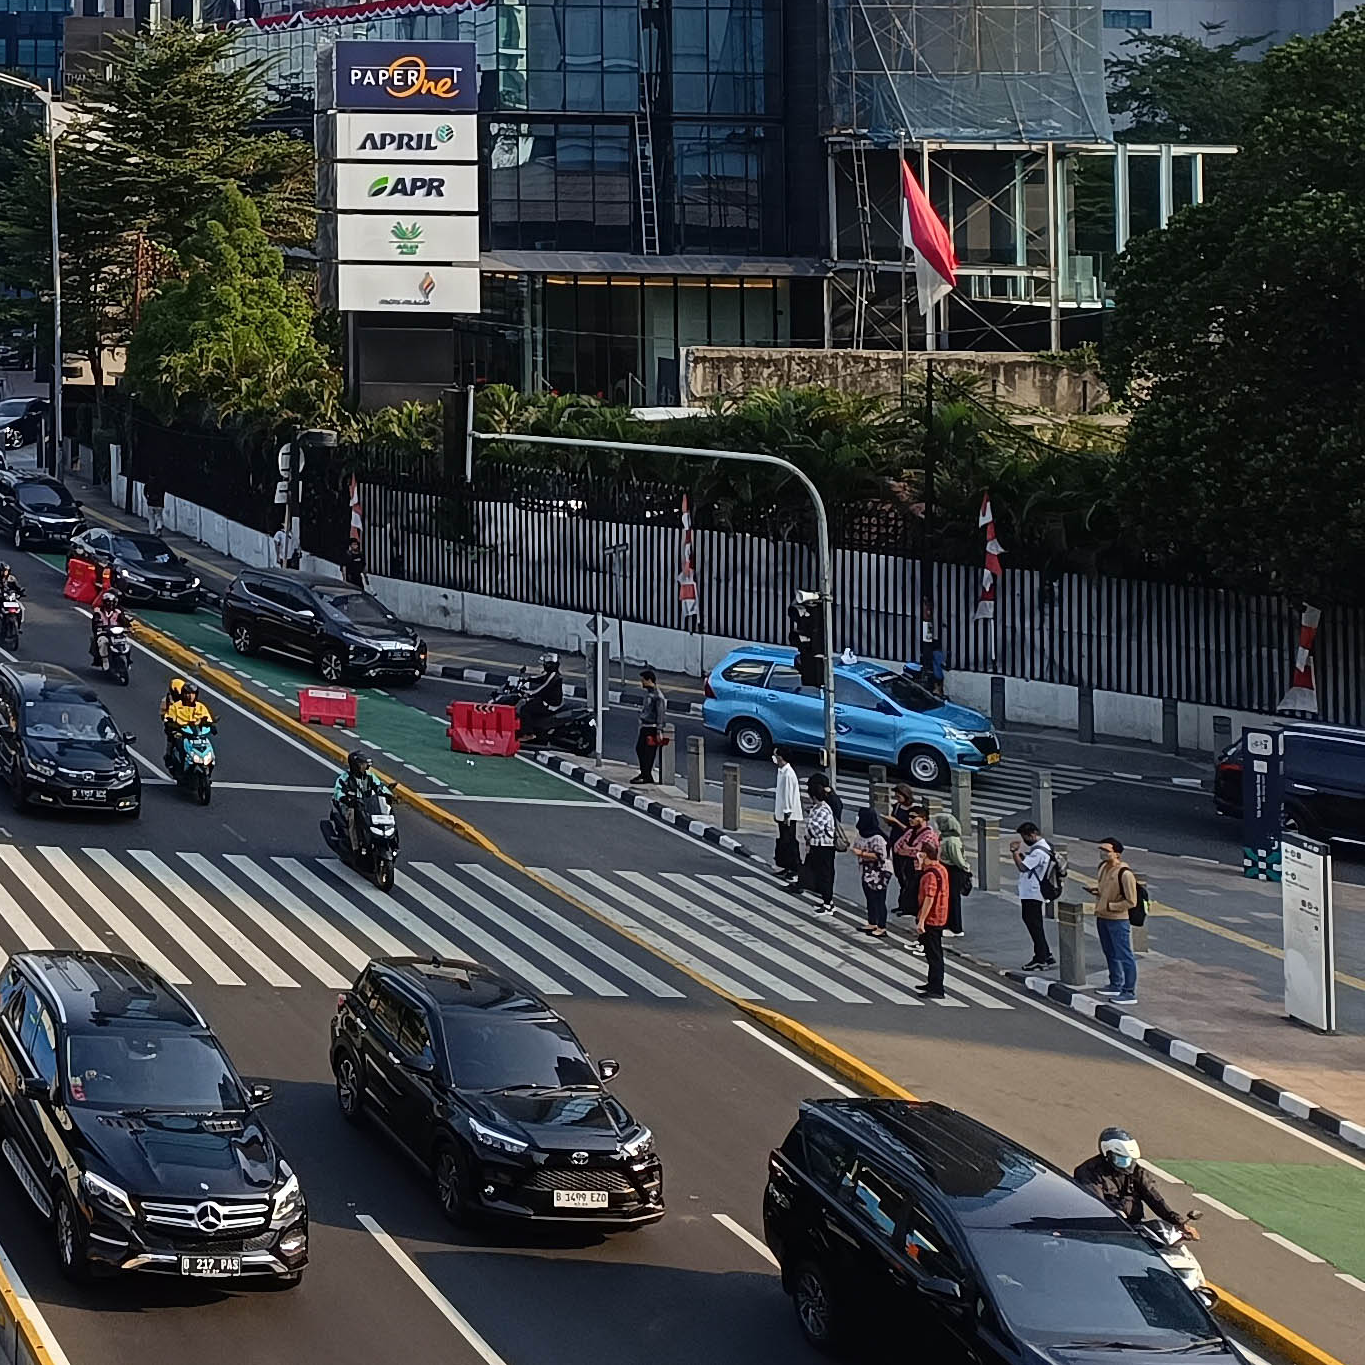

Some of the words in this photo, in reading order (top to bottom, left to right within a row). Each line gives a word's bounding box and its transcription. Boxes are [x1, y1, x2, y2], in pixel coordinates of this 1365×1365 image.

[350, 69, 418, 86] PAPER
[386, 56, 460, 98] One
[357, 132, 438, 151] APRIL
[386, 177, 446, 198] APR
[556, 1192, 562, 1202] B
[590, 1192, 607, 1203] EZO
[196, 1258, 215, 1270] 217
[220, 1259, 239, 1270] PAS
